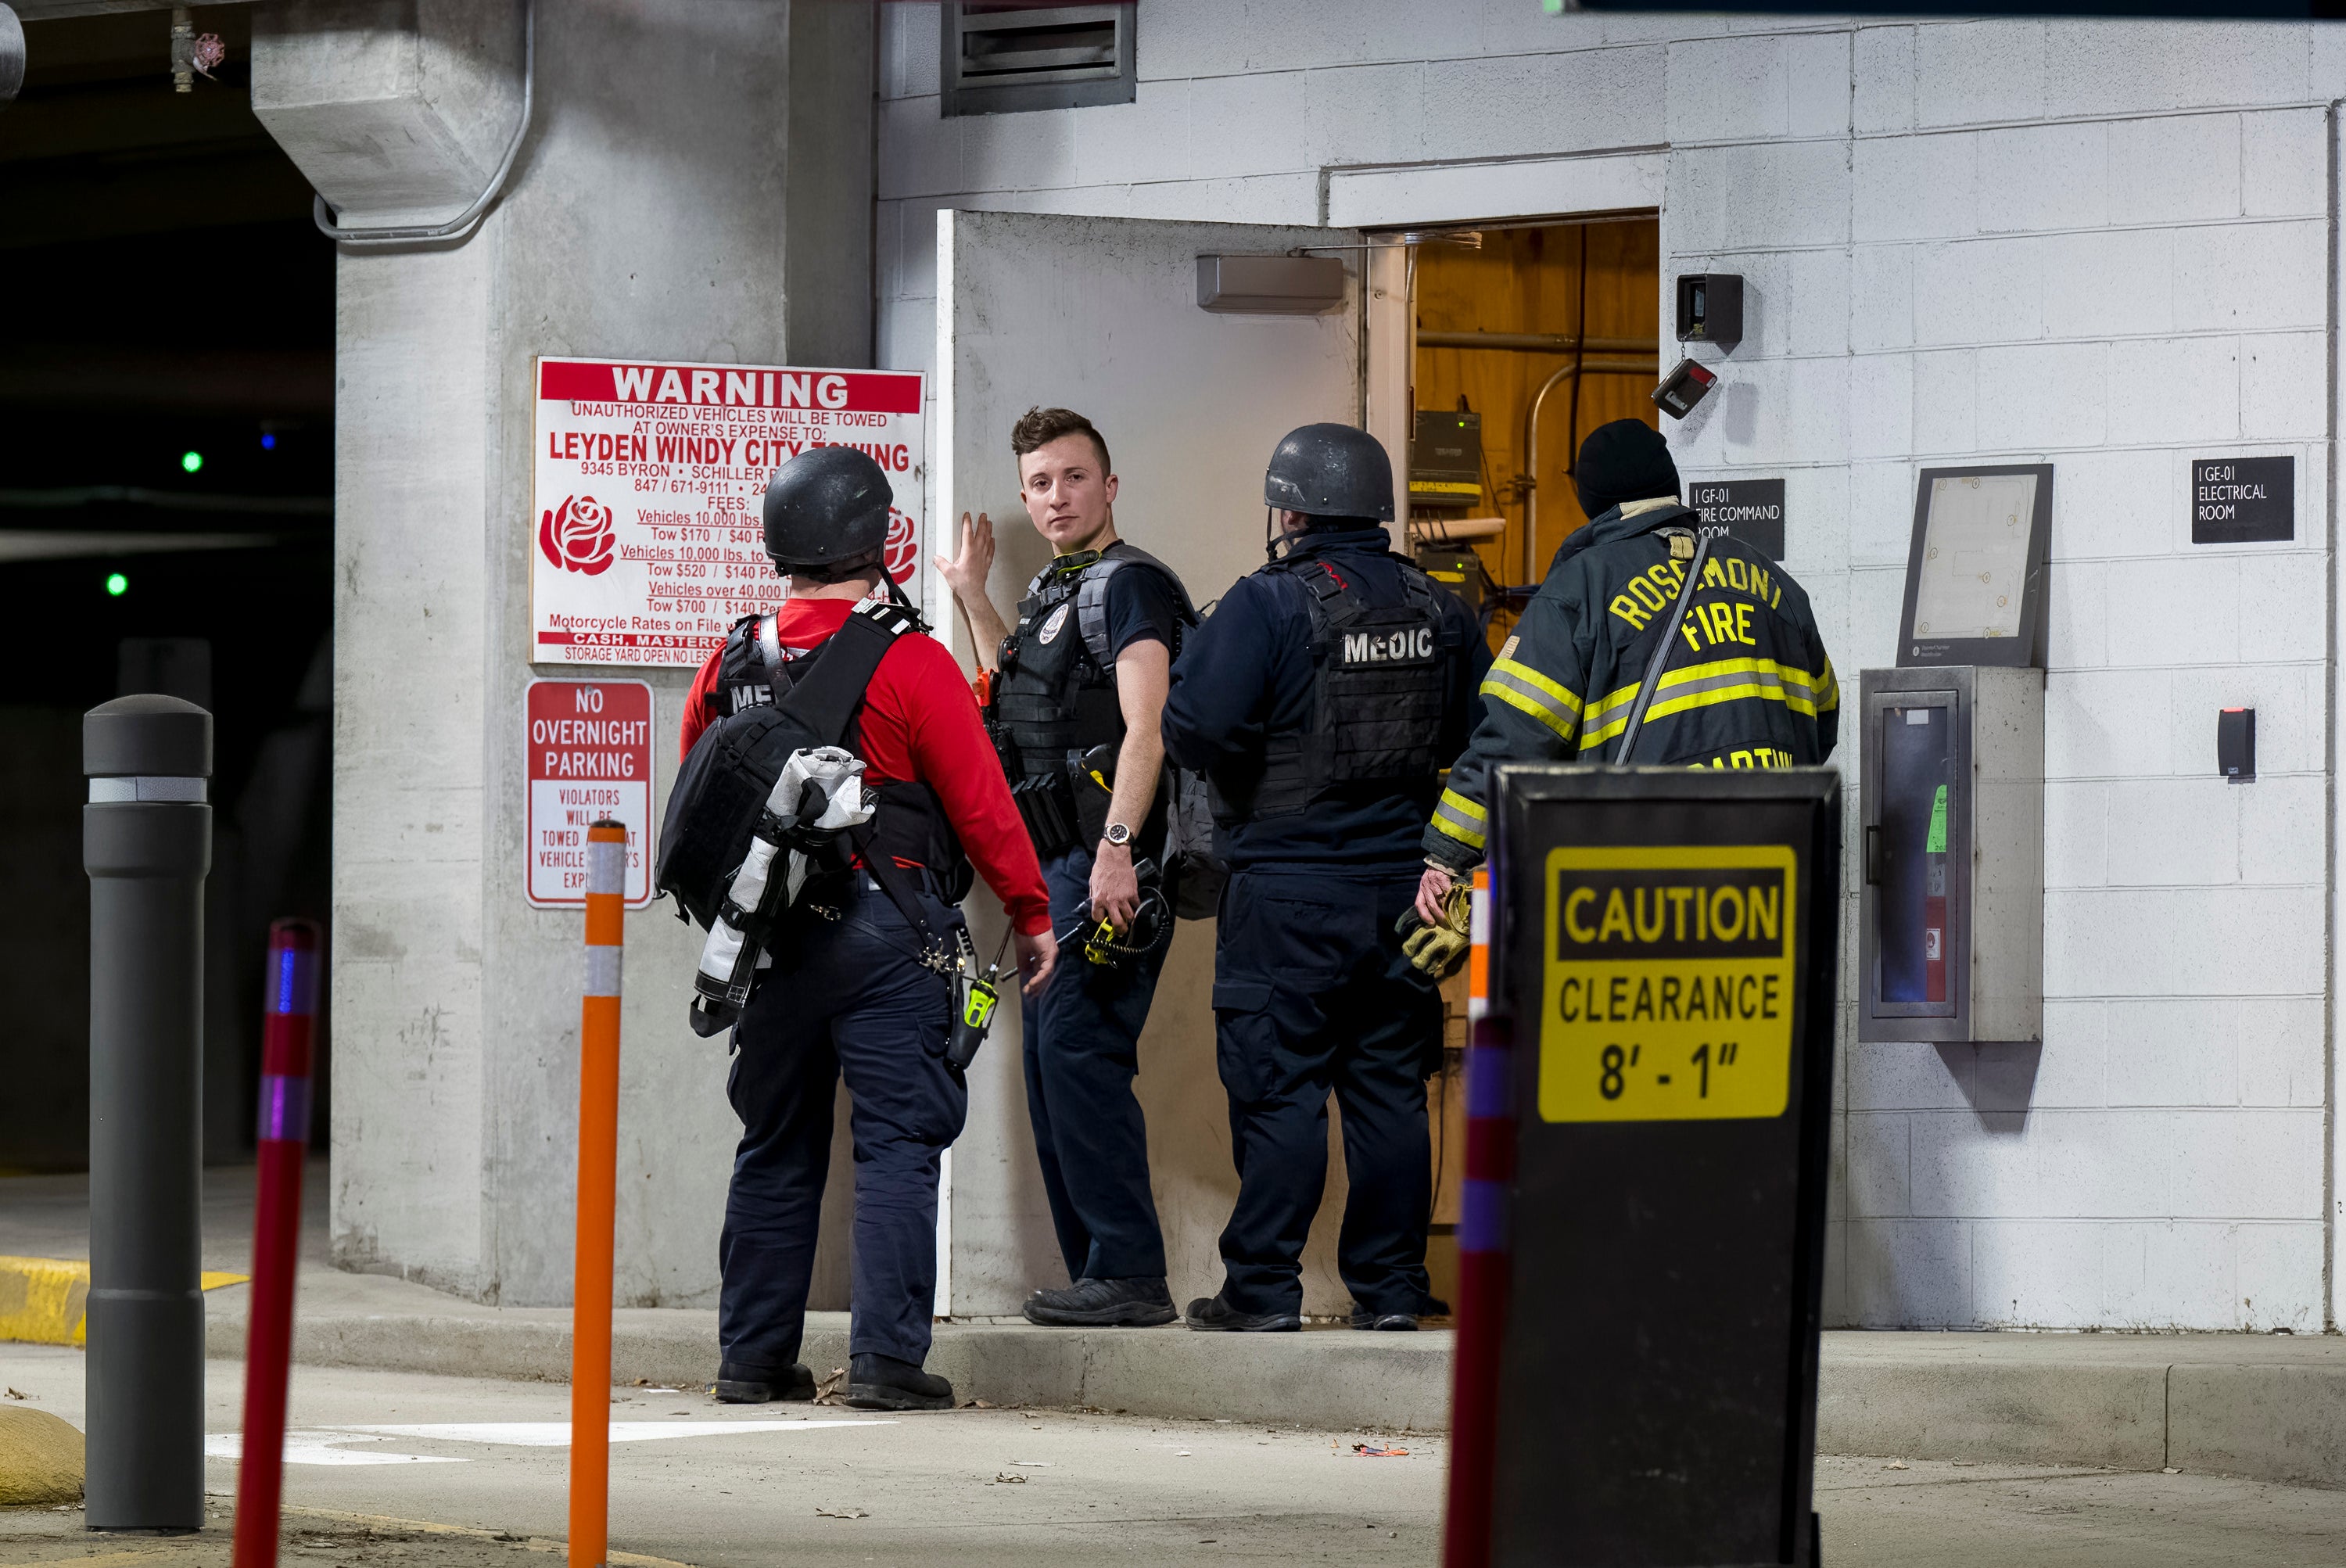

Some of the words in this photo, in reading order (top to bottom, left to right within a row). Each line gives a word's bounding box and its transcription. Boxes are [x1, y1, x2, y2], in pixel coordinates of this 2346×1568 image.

[612, 367, 848, 409] WARNING
[572, 403, 688, 421] UNAUTHORIZED
[693, 407, 766, 423] VEHICLES
[770, 411, 806, 425] WILL
[811, 412, 830, 425] BE
[834, 413, 887, 427] TOWED
[633, 422, 651, 434] AT
[655, 423, 724, 437] OWNER'S
[729, 425, 798, 440] EXPENSE
[803, 427, 827, 440] TO:
[550, 432, 647, 462] LEYDEN
[655, 436, 737, 465] WINDY
[744, 440, 803, 467] CITY
[581, 462, 614, 475] 9345
[618, 464, 670, 478] BYRON
[691, 465, 764, 481] SCHILLER
[2205, 465, 2235, 482] GE-01
[634, 479, 658, 493] 847
[671, 480, 729, 495] 671-9111
[1702, 488, 1729, 504] GF-01
[2199, 484, 2268, 501] ELECTRICAL
[707, 497, 749, 511] FEES:
[2199, 504, 2235, 521] ROOM
[637, 509, 691, 524] Vehicles
[740, 513, 763, 526] lbs.
[1720, 505, 1780, 522] COMMAND
[651, 526, 677, 540] Tow
[680, 527, 710, 542] $170
[729, 529, 752, 544] $40
[1698, 526, 1729, 539] OOM
[620, 544, 675, 559] Vehicles
[723, 548, 747, 562] lbs.
[751, 550, 764, 562] to
[647, 563, 673, 576] Tow
[676, 563, 706, 578] $520
[725, 565, 755, 579] $140
[759, 566, 780, 580] Pe
[648, 581, 702, 596] Vehicles
[706, 585, 735, 597] over
[738, 584, 781, 599] 40,000
[646, 598, 673, 612] Tow
[676, 599, 706, 614] $700
[725, 601, 755, 615] $140
[549, 614, 626, 632] Motorcycle
[632, 616, 674, 630] Rates
[676, 620, 693, 632] on
[697, 618, 721, 632] File
[1681, 602, 1756, 652] FIRE
[1344, 627, 1433, 663] MEDIC
[565, 647, 612, 662] STORAGE
[615, 648, 640, 662] YARD
[644, 649, 671, 662] OPEN
[673, 650, 687, 663] NO
[576, 688, 604, 713] NO
[533, 719, 647, 745] OVERNIGHT
[545, 752, 634, 777] PARKING
[559, 788, 620, 806] VIOLATORS
[566, 810, 591, 826] WILL
[542, 831, 579, 846] TOWED
[540, 852, 585, 867] VEHICLE
[1564, 885, 1779, 944] CAUTION
[1559, 974, 1779, 1024] CLEARANCE
[1599, 1043, 1640, 1101] 8'
